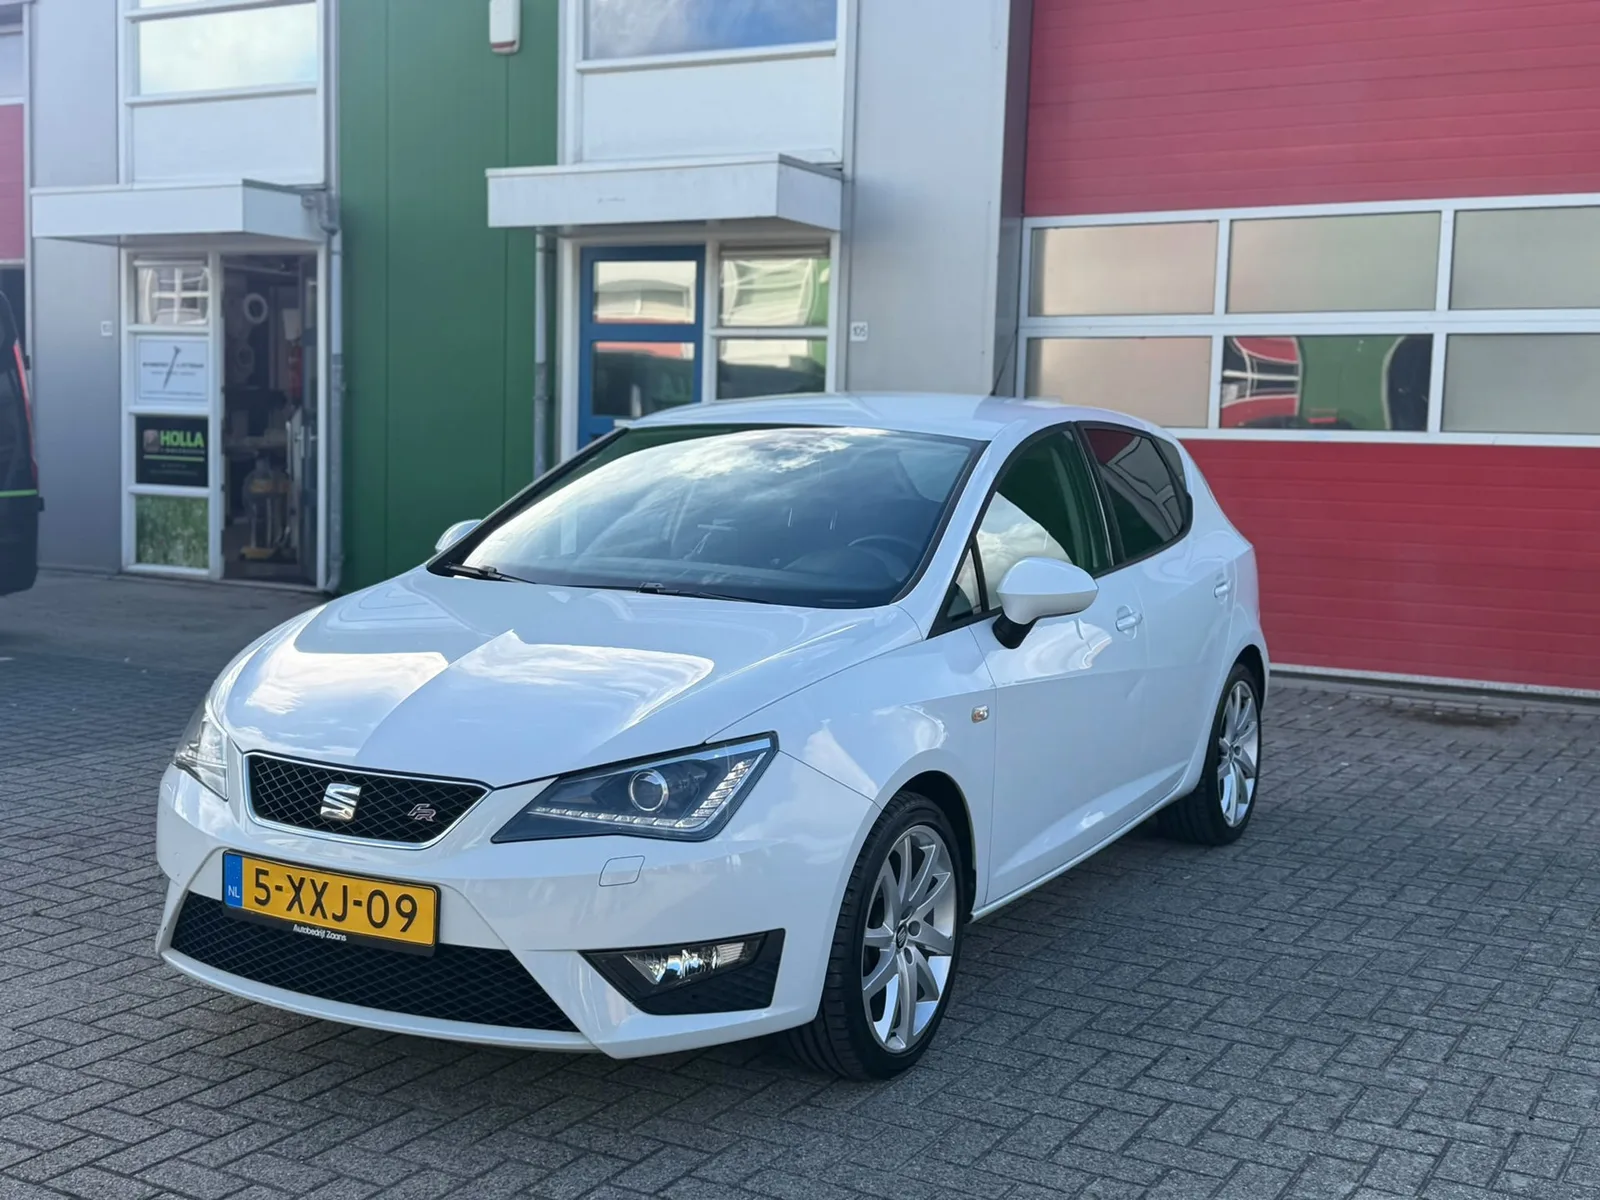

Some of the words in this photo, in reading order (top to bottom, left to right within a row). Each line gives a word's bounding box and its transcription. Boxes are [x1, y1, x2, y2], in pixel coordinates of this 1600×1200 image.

[160, 430, 205, 448] HOLLA
[228, 885, 240, 898] NL
[254, 867, 418, 932] 5-XXJ-09
